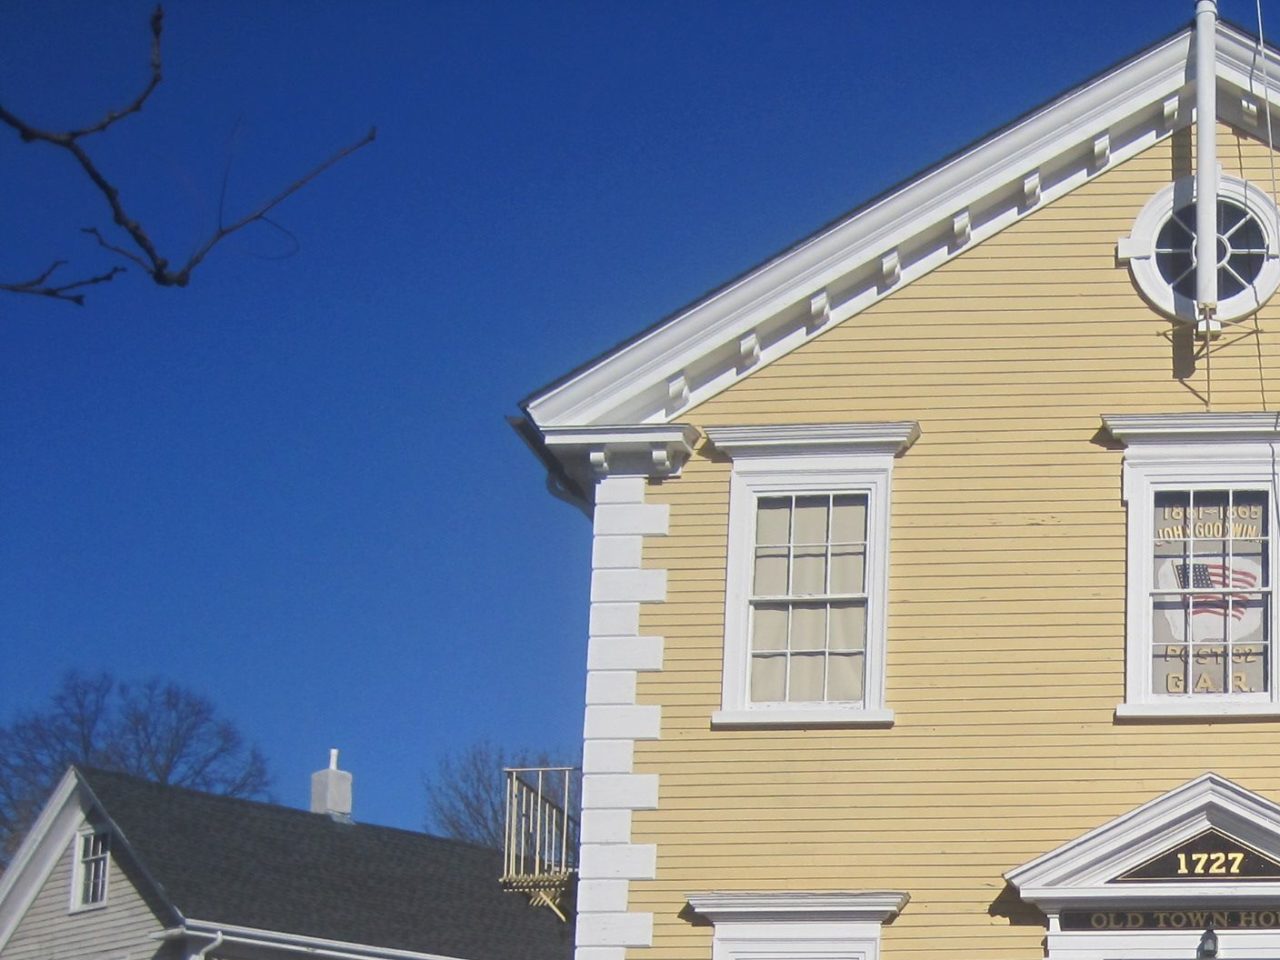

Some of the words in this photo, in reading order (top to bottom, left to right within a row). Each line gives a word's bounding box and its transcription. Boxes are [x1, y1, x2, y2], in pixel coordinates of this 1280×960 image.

[1177, 852, 1245, 874] 1727
[1090, 911, 1144, 929] OLD
[1153, 911, 1229, 929] TOWN
